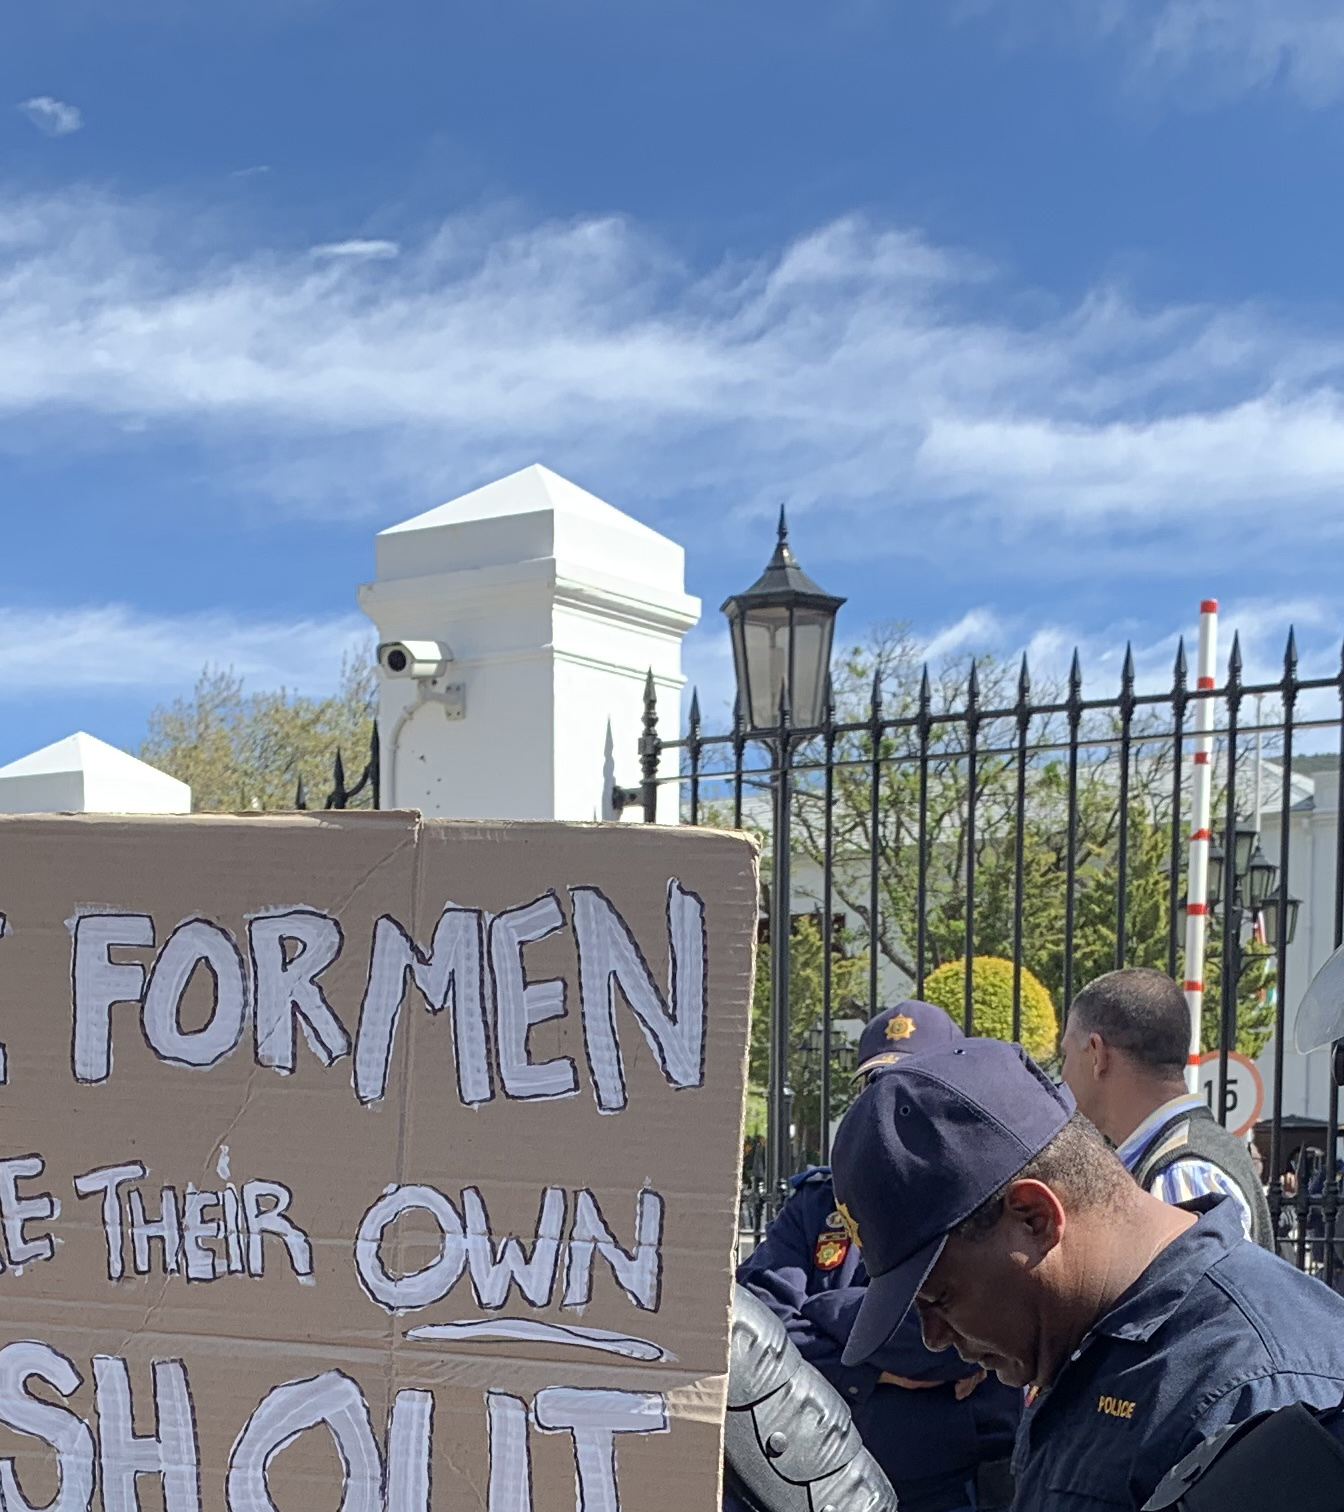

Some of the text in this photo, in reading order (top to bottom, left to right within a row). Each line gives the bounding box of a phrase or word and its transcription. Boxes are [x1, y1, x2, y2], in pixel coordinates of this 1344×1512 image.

[67, 904, 352, 1086] FOR
[352, 877, 707, 1114] MEN
[1204, 1078, 1238, 1112] 15
[352, 1179, 665, 1316] OWN
[1097, 1395, 1136, 1419] POLICE
